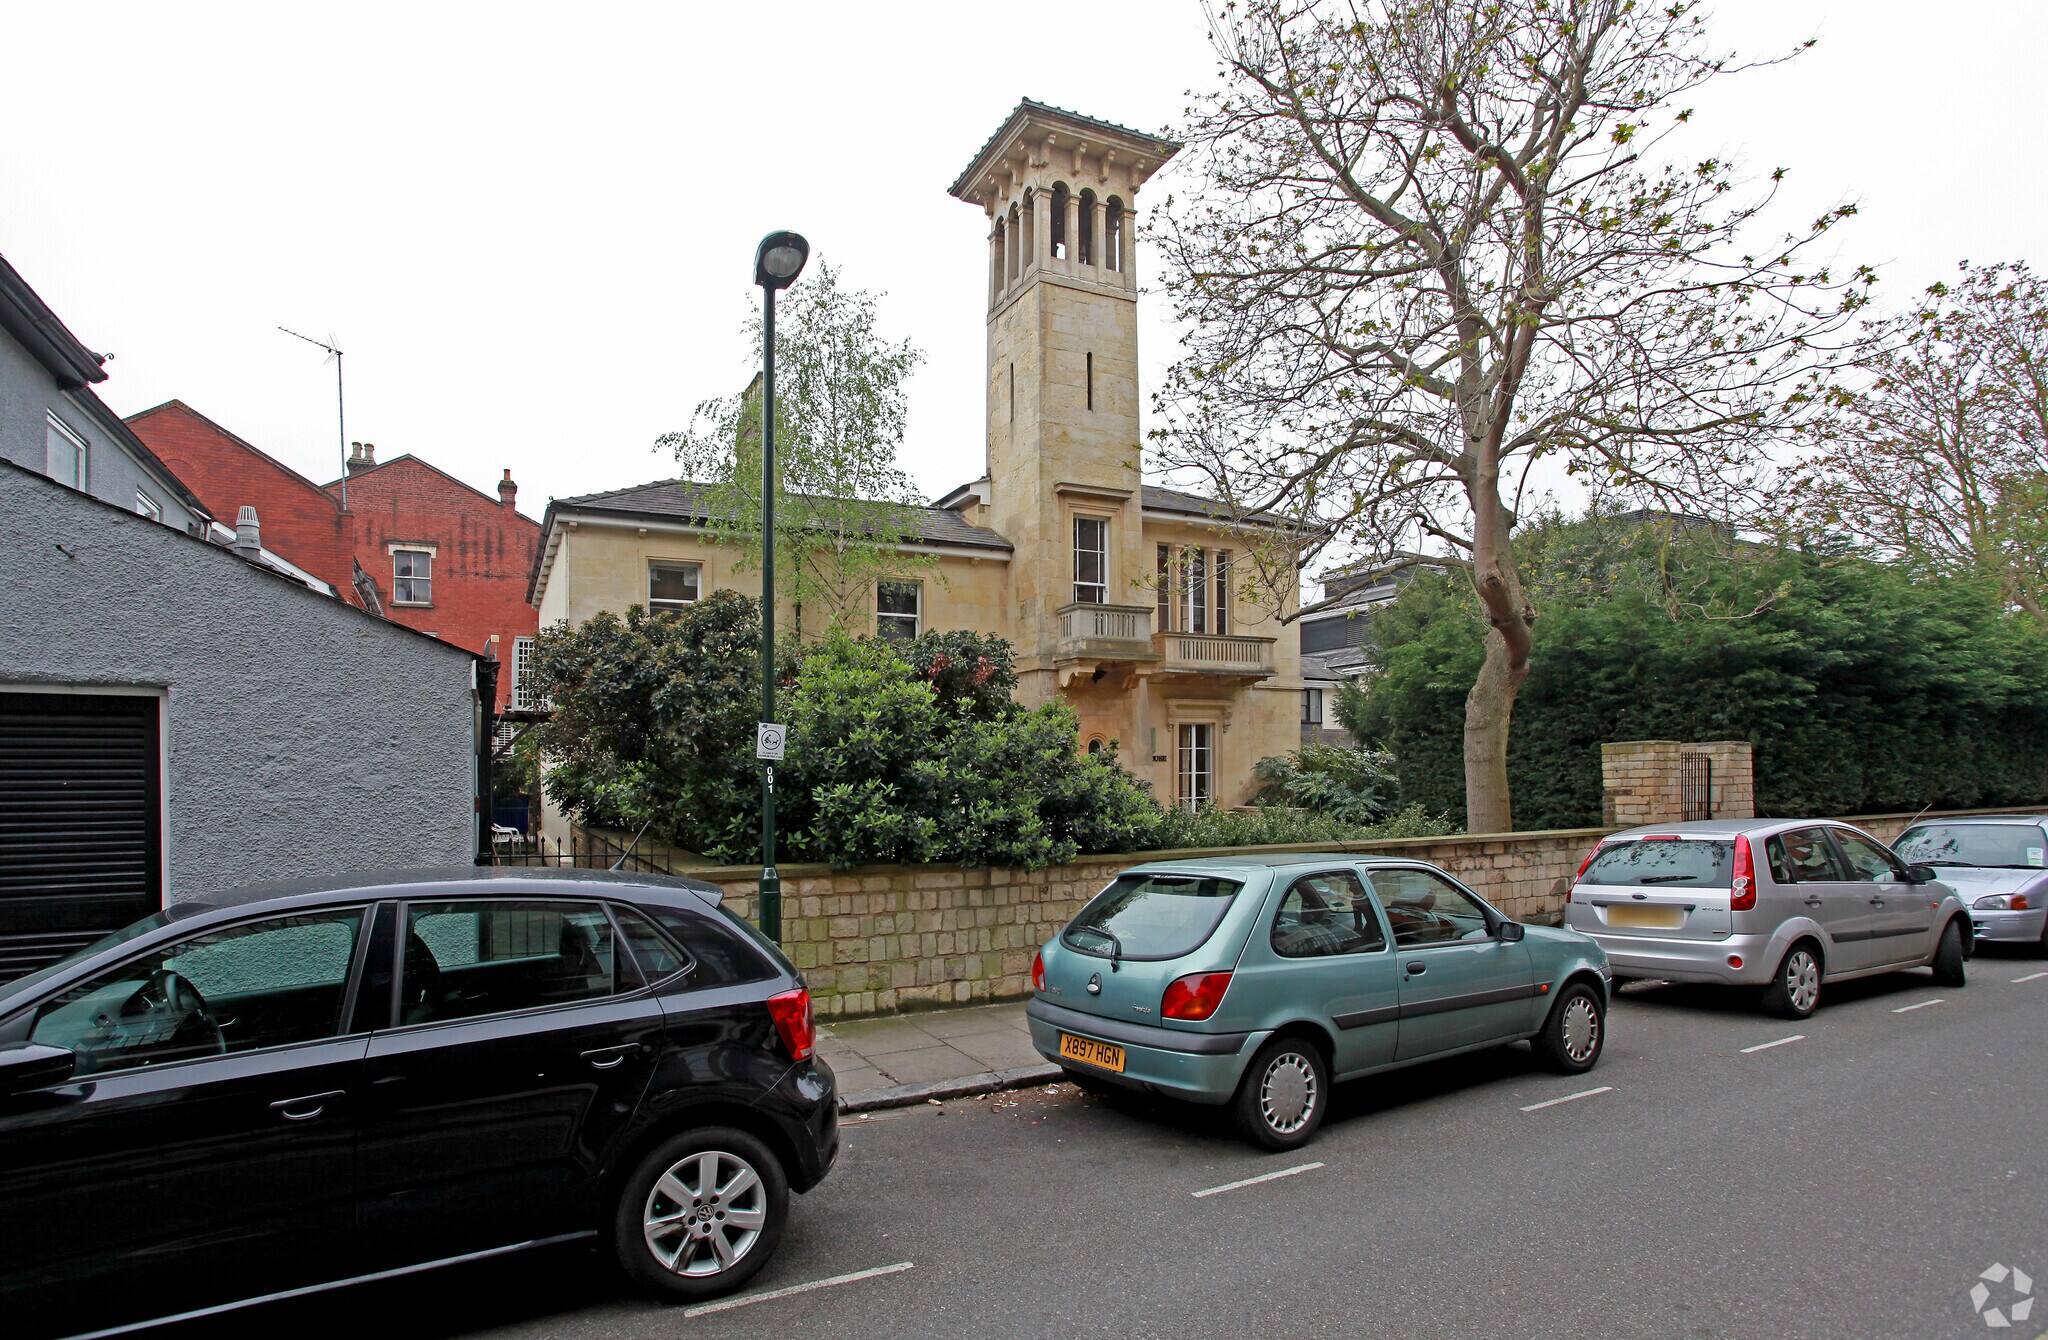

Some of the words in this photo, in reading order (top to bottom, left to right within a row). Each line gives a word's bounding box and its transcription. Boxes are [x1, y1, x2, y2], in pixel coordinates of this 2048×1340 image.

[766, 766, 774, 794] 001
[1065, 1036, 1094, 1058] X897
[1096, 1045, 1120, 1066] HGN
